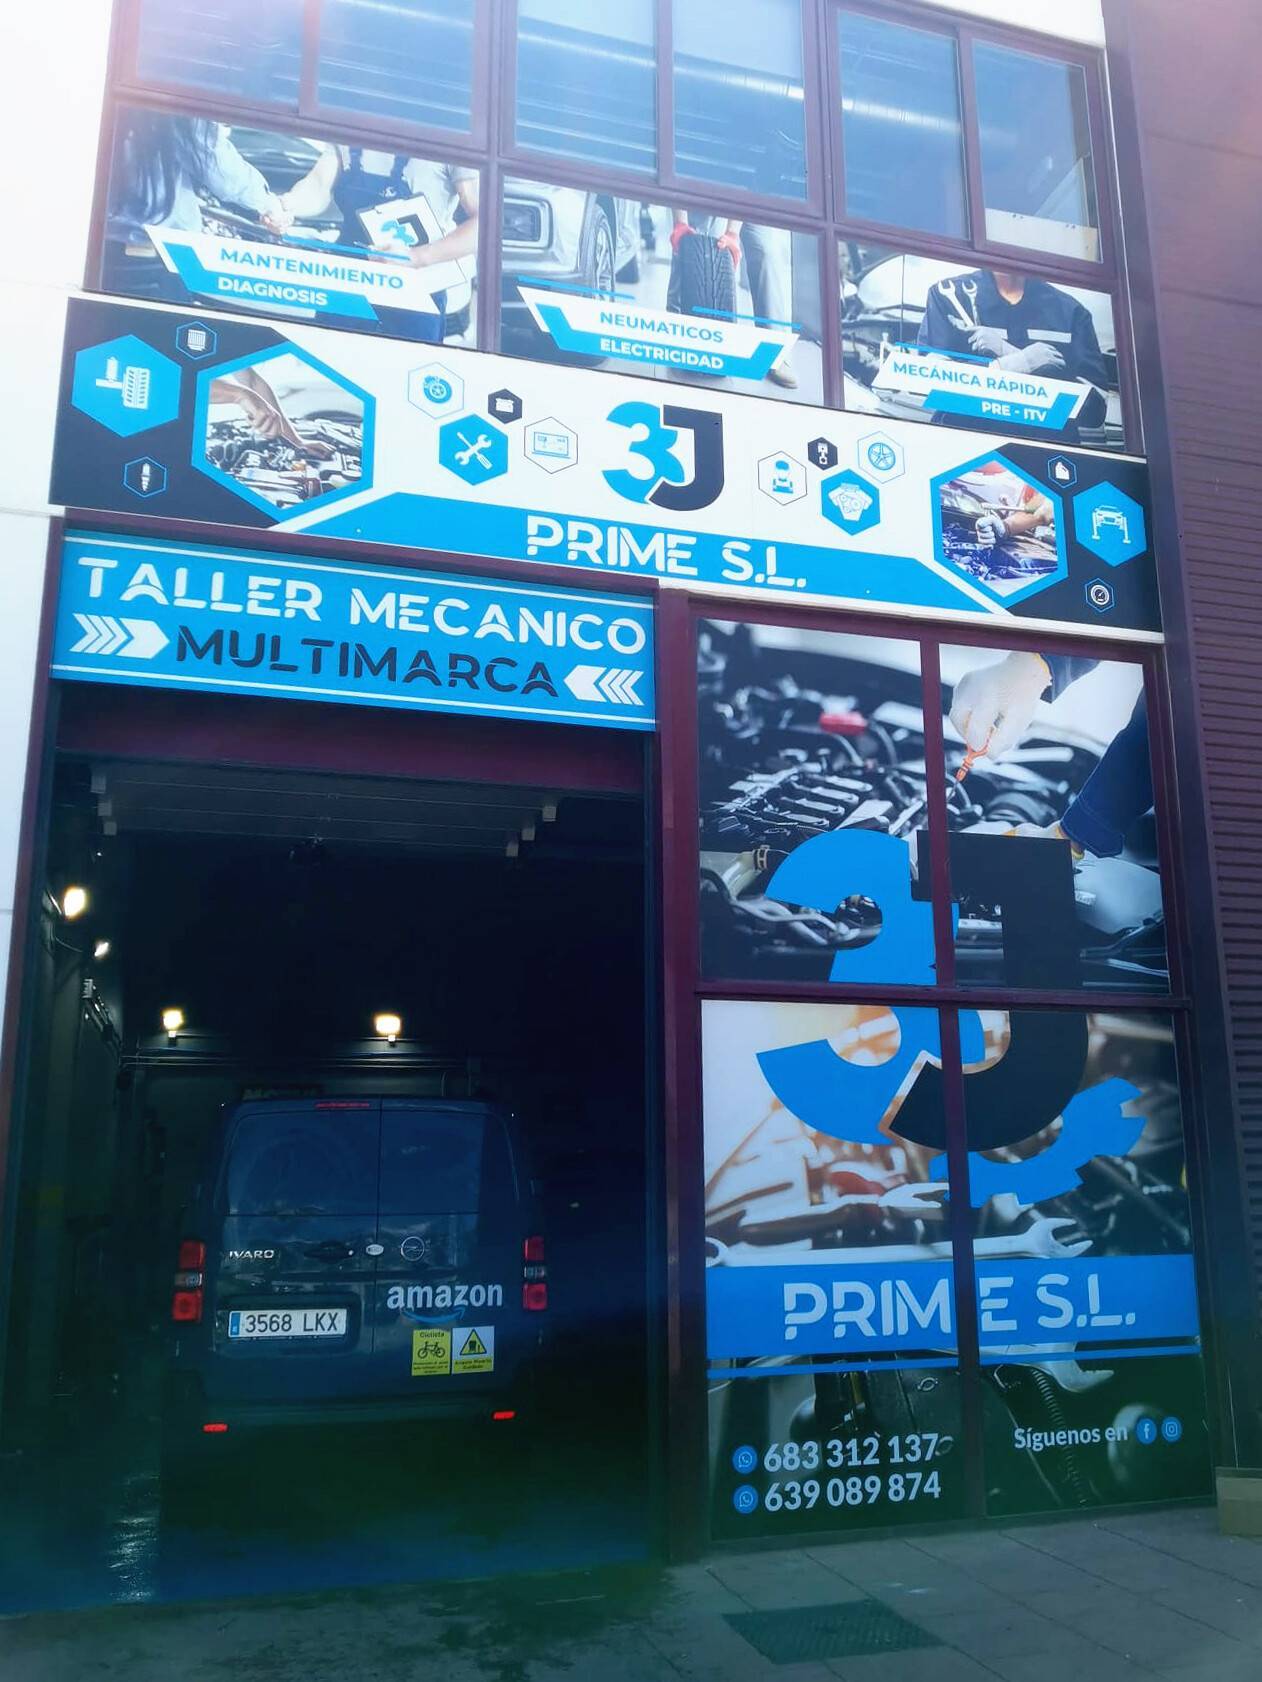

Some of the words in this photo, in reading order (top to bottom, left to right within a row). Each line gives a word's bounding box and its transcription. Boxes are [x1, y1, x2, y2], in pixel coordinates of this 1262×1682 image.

[220, 248, 404, 289] MANTENIMIENTO
[217, 276, 328, 306] DIAGNOSIS
[600, 311, 723, 343] NEUMATICOS
[600, 338, 724, 369] ELECTRICIDAD
[893, 361, 981, 387] MECÁNICA
[986, 376, 1048, 398] RÁPIDA
[981, 401, 1011, 416] PRE
[1023, 409, 1047, 422] ITV
[602, 401, 725, 512] 3J
[527, 515, 698, 576] PRIME
[721, 541, 807, 588] S.L.
[78, 557, 322, 621] TALLER
[350, 588, 646, 655] MECANICO
[176, 625, 559, 697] MULTIMARCA
[386, 1284, 503, 1309] amazon
[784, 1277, 1018, 1340] PRIME
[1036, 1273, 1136, 1329] S.L.
[245, 1314, 292, 1333] 3568
[303, 1312, 338, 1332] LKX
[763, 1441, 820, 1472] 683
[827, 1437, 880, 1468] 312
[887, 1433, 939, 1464] 137
[1014, 1426, 1100, 1452] Síguenos
[1105, 1424, 1128, 1442] en
[764, 1480, 820, 1512] 639
[826, 1475, 882, 1507] 089
[888, 1471, 942, 1502] 874
